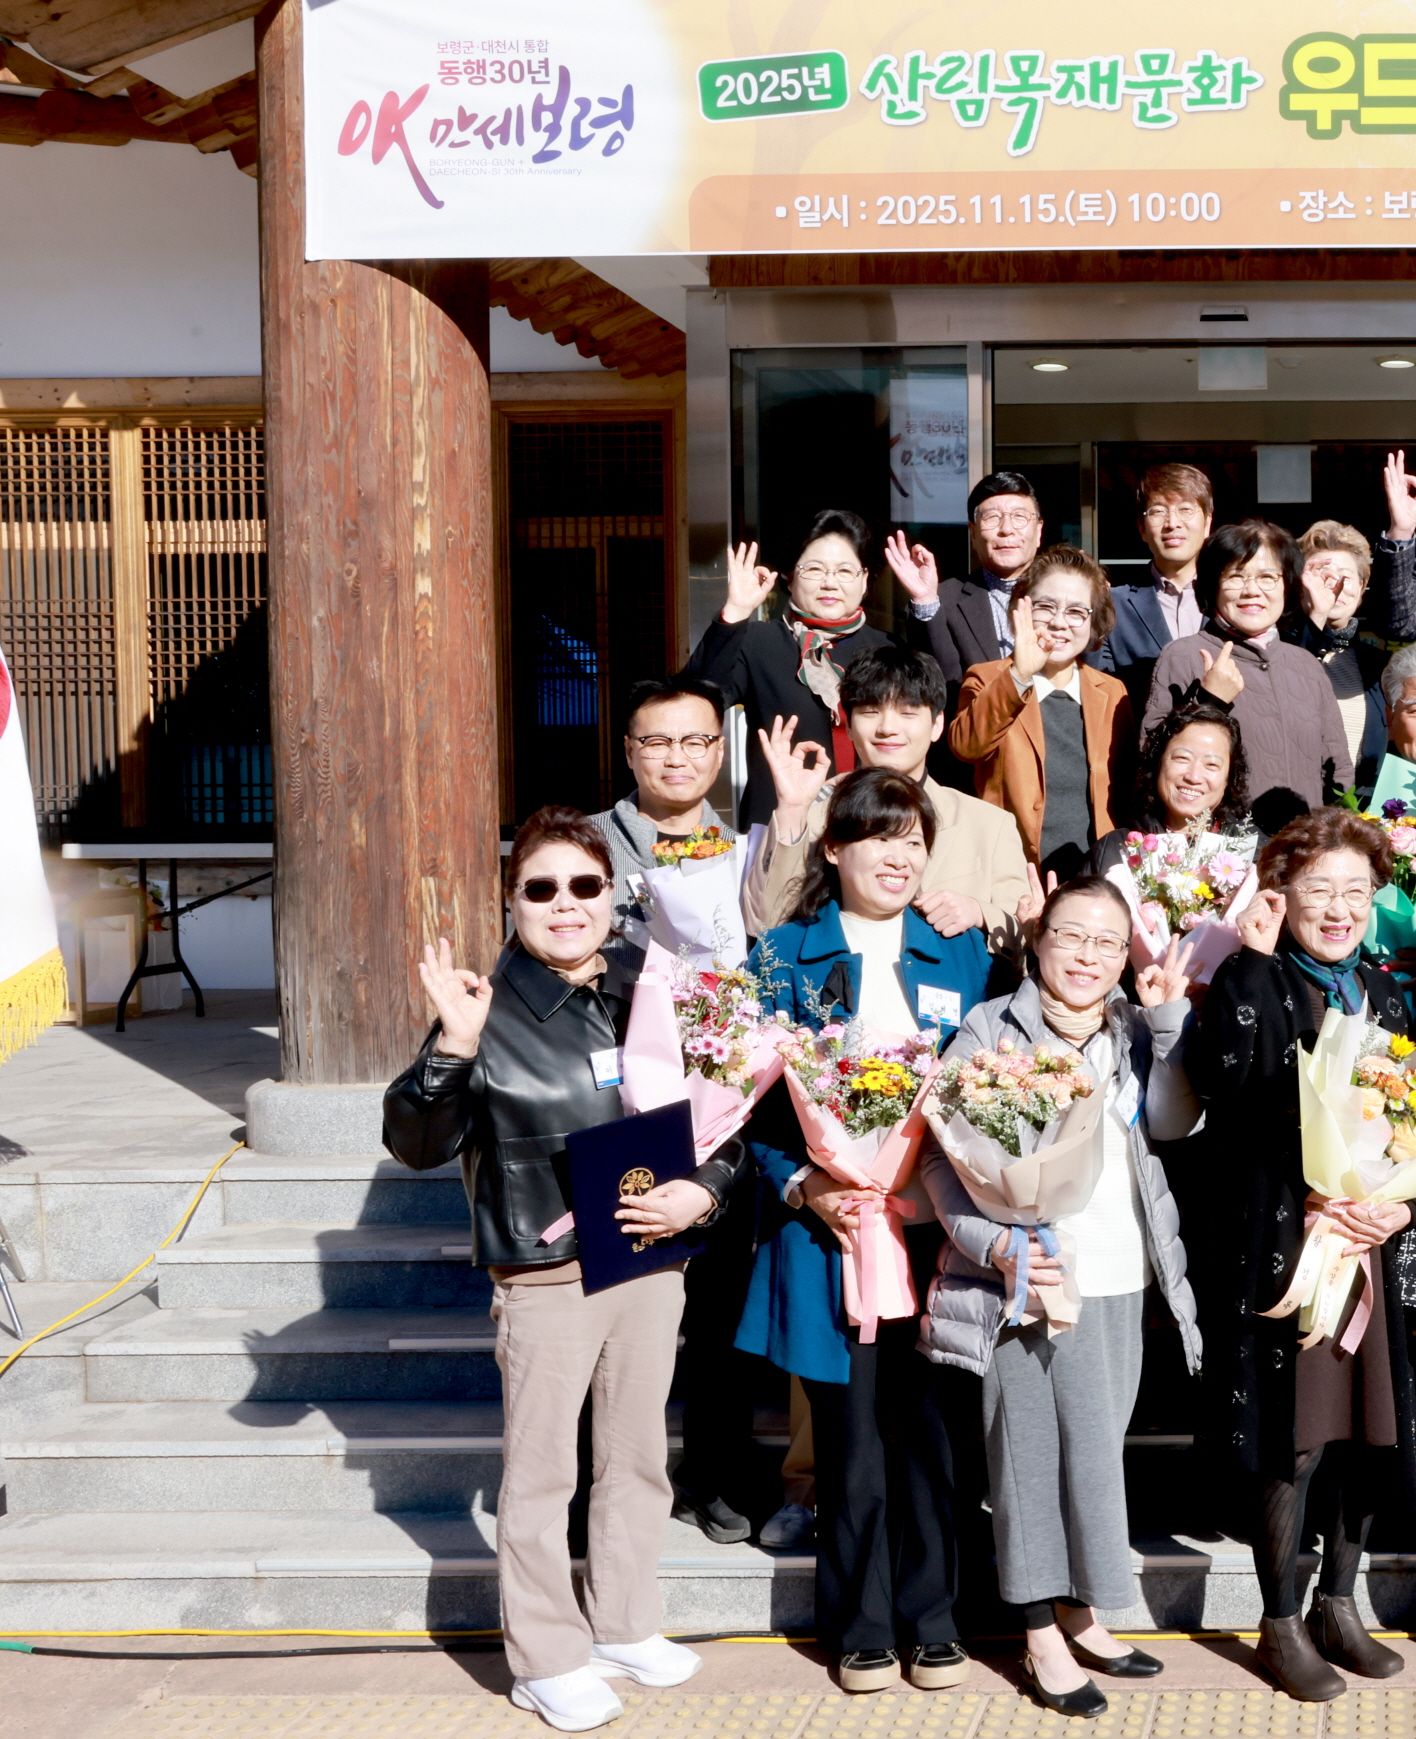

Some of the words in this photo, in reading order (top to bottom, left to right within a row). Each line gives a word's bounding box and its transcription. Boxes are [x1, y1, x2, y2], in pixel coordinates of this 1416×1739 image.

[524, 38, 549, 54] 통합
[437, 57, 551, 86] 동행30년
[714, 61, 833, 109] 2025년
[863, 51, 1261, 154] 산림목재문화
[429, 158, 515, 167] BORYEONG-GUN
[429, 167, 501, 176] DAECHEON-SI
[503, 166, 525, 176] 30th
[526, 166, 583, 177] Anniversary
[793, 194, 850, 228] 일시
[876, 189, 1118, 227] 2025.11.15.(토)
[1128, 191, 1222, 223] 10:00
[1298, 189, 1357, 223] 장소
